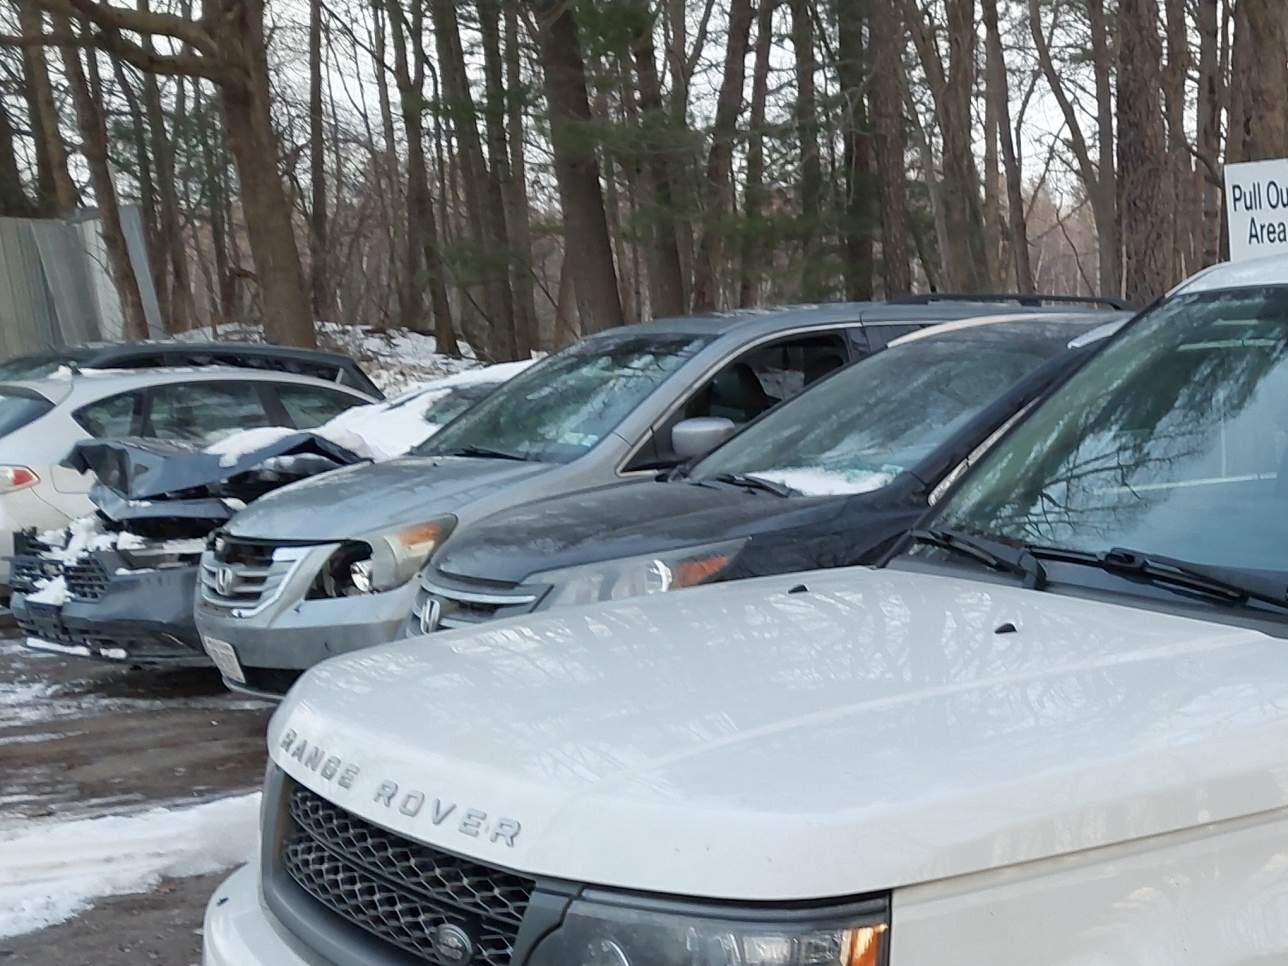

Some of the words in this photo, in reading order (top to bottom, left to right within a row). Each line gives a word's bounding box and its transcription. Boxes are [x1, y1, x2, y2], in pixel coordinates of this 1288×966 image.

[1231, 181, 1262, 212] Pull
[1248, 216, 1287, 245] Area
[280, 728, 360, 790] RANGE
[373, 779, 522, 848] ROVER
